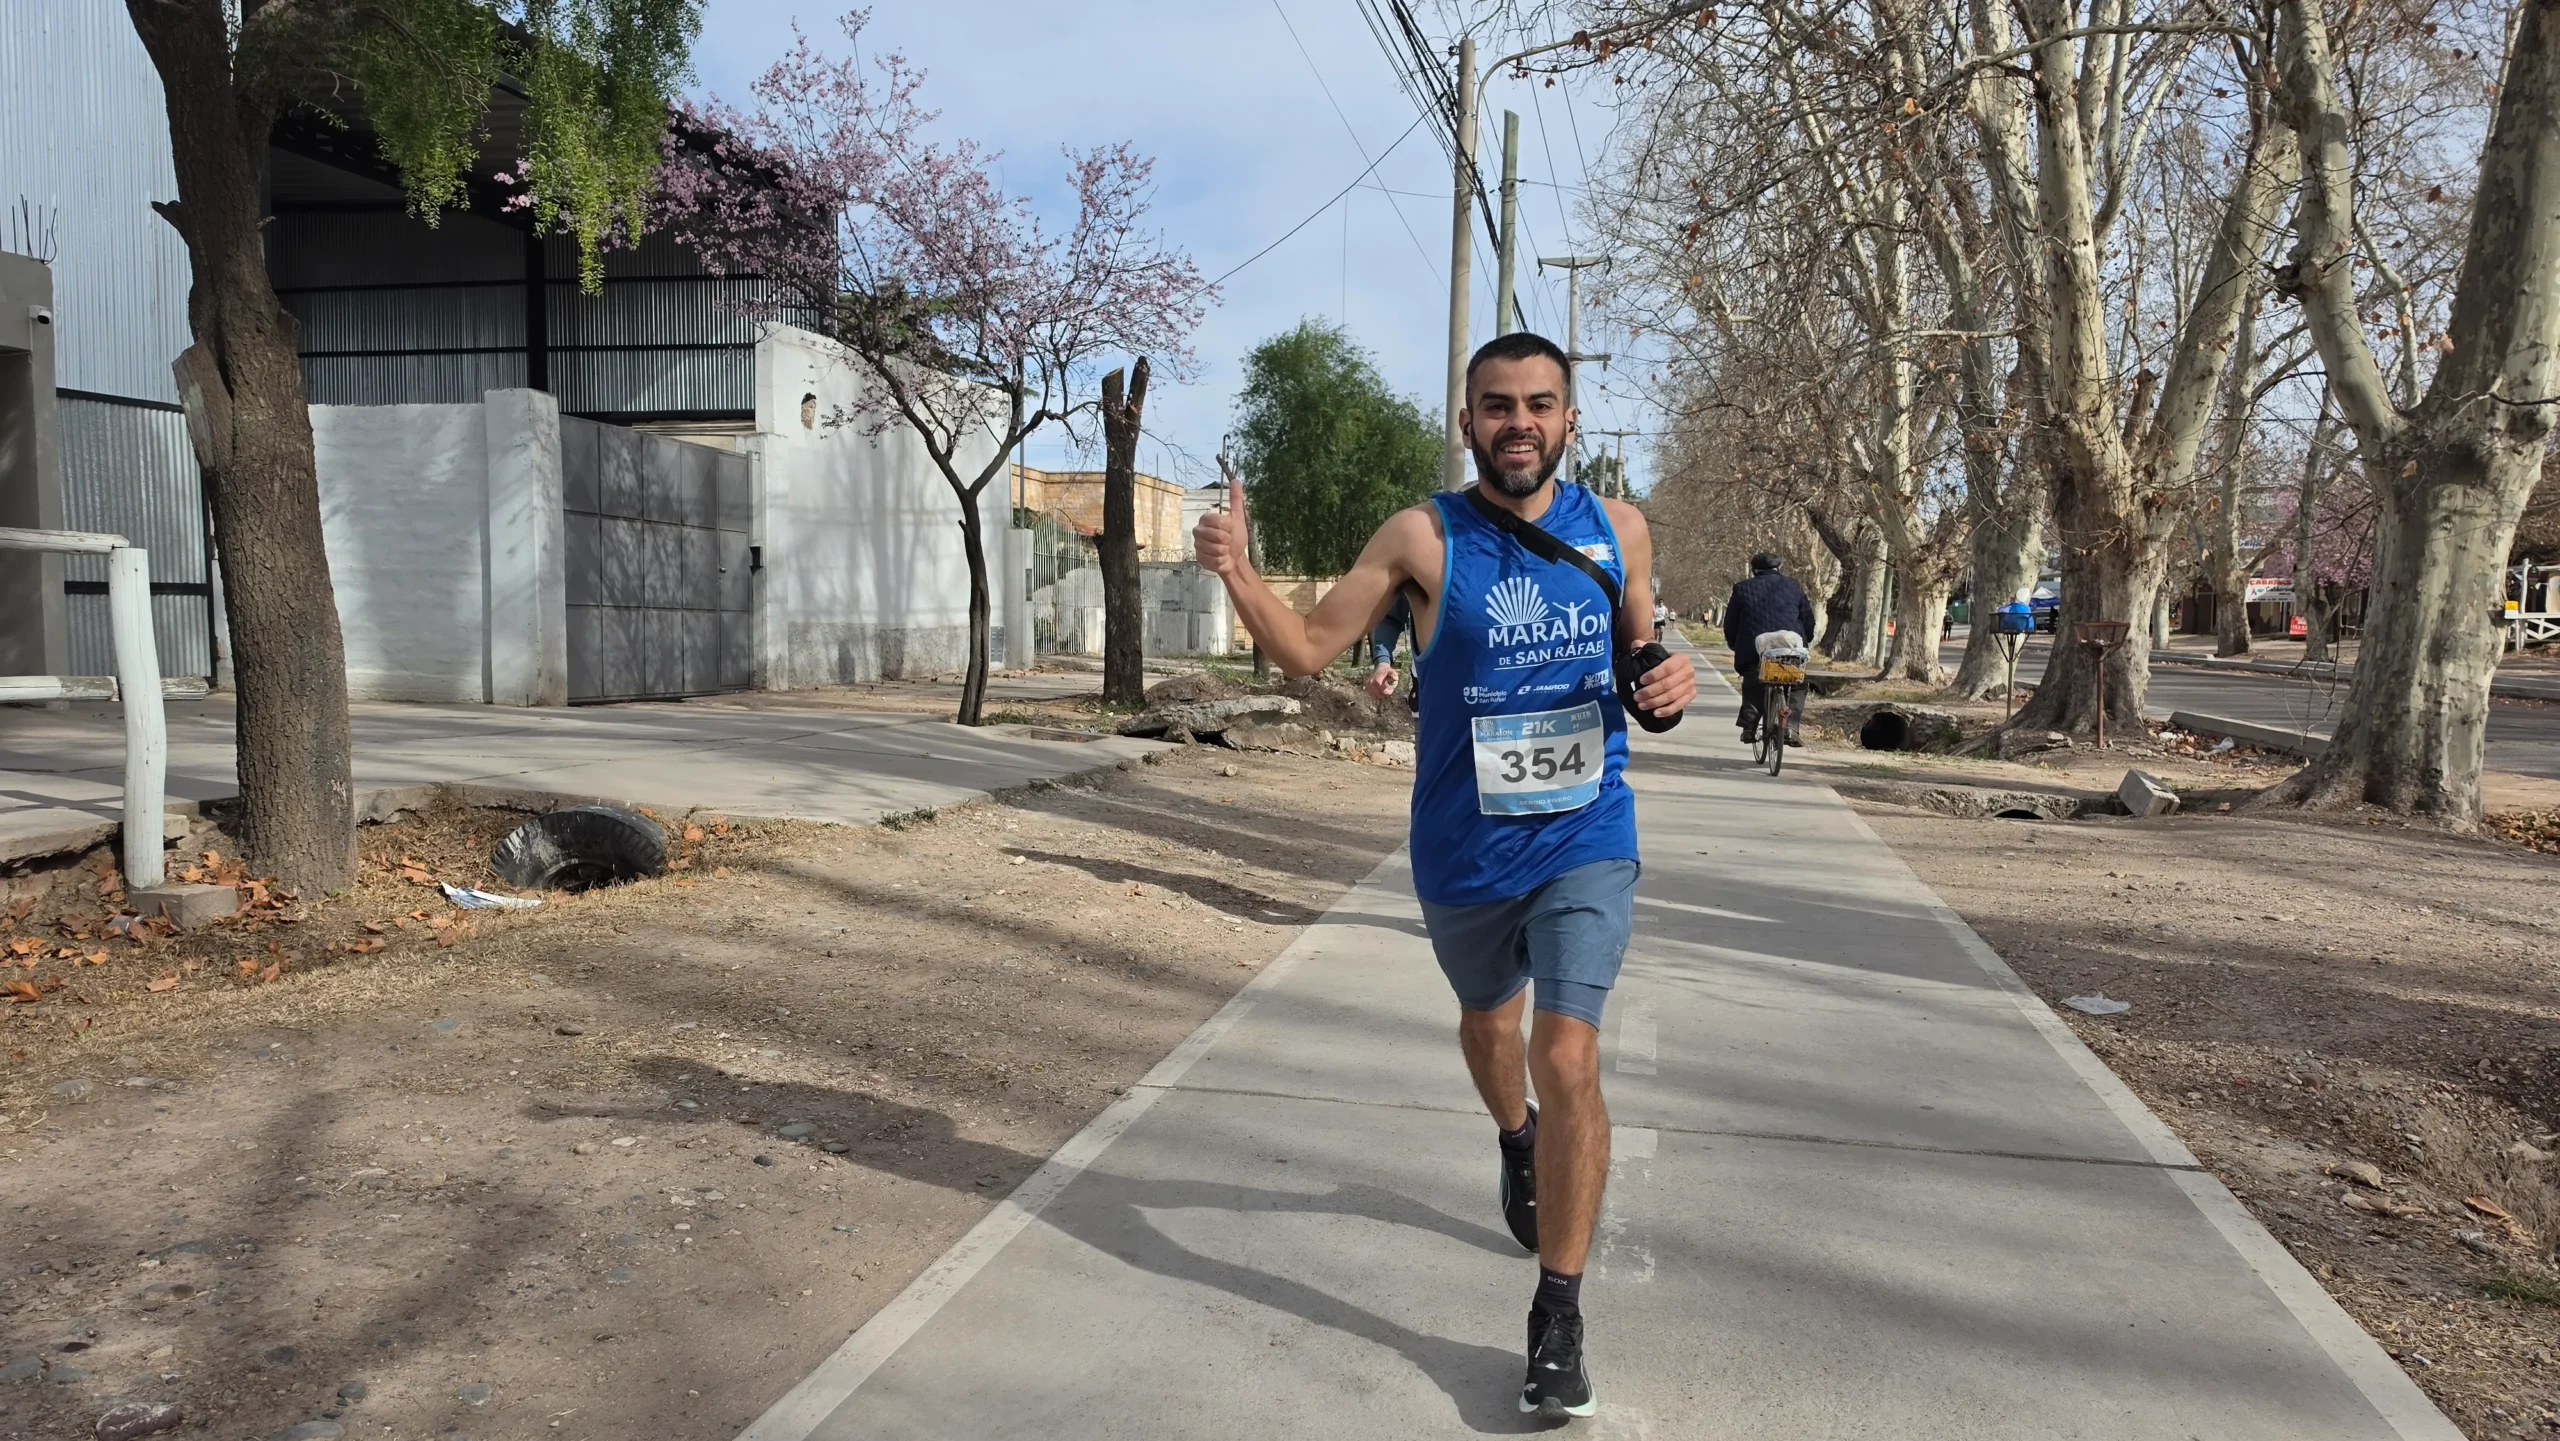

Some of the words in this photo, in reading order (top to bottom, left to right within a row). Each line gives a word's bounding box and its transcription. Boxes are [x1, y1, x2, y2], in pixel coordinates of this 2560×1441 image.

[1488, 601, 1610, 649] MARATON
[1499, 656, 1511, 666] DE
[1515, 648, 1552, 665] SAN
[1554, 639, 1605, 658] RAFAEL
[1521, 719, 1558, 735] 21K
[1501, 742, 1585, 783] 354
